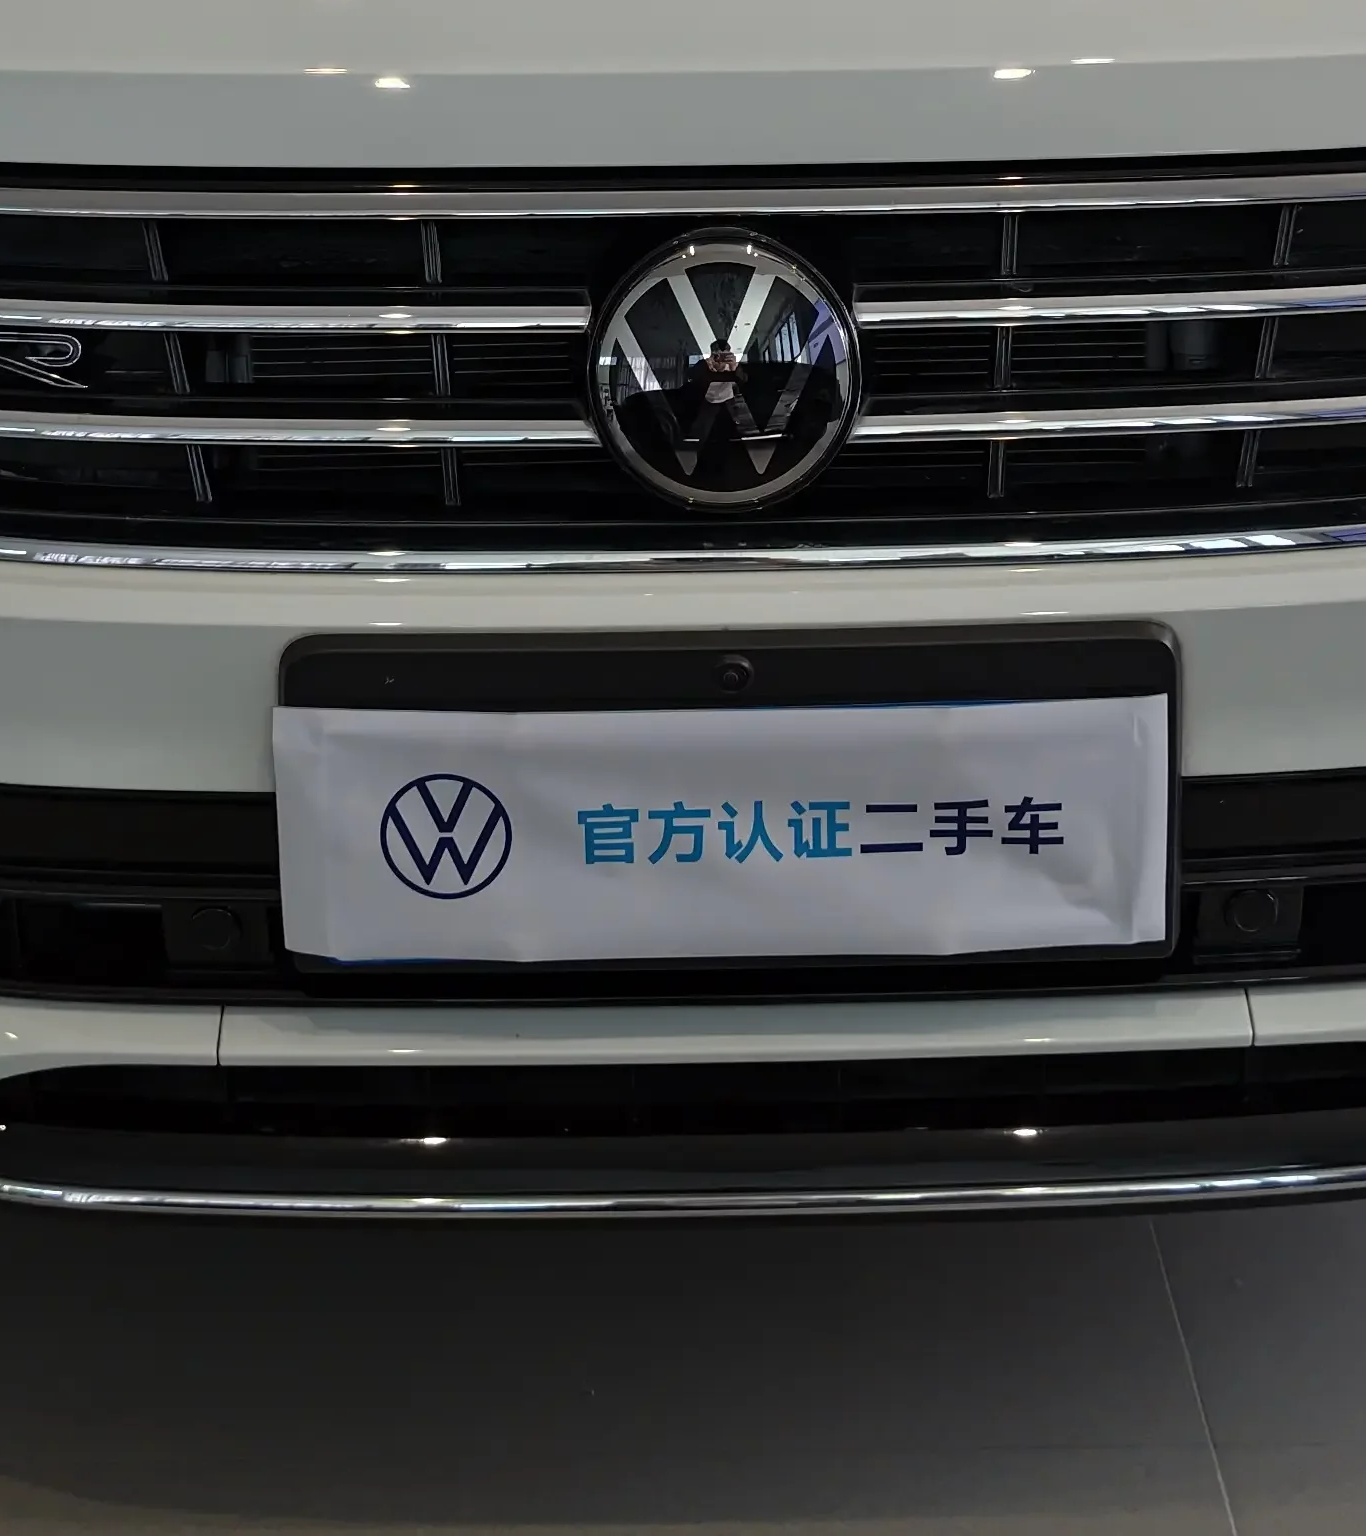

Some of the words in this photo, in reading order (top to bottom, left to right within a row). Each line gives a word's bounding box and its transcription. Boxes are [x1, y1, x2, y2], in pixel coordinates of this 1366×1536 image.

[577, 796, 1065, 865] 官方认证二手车
